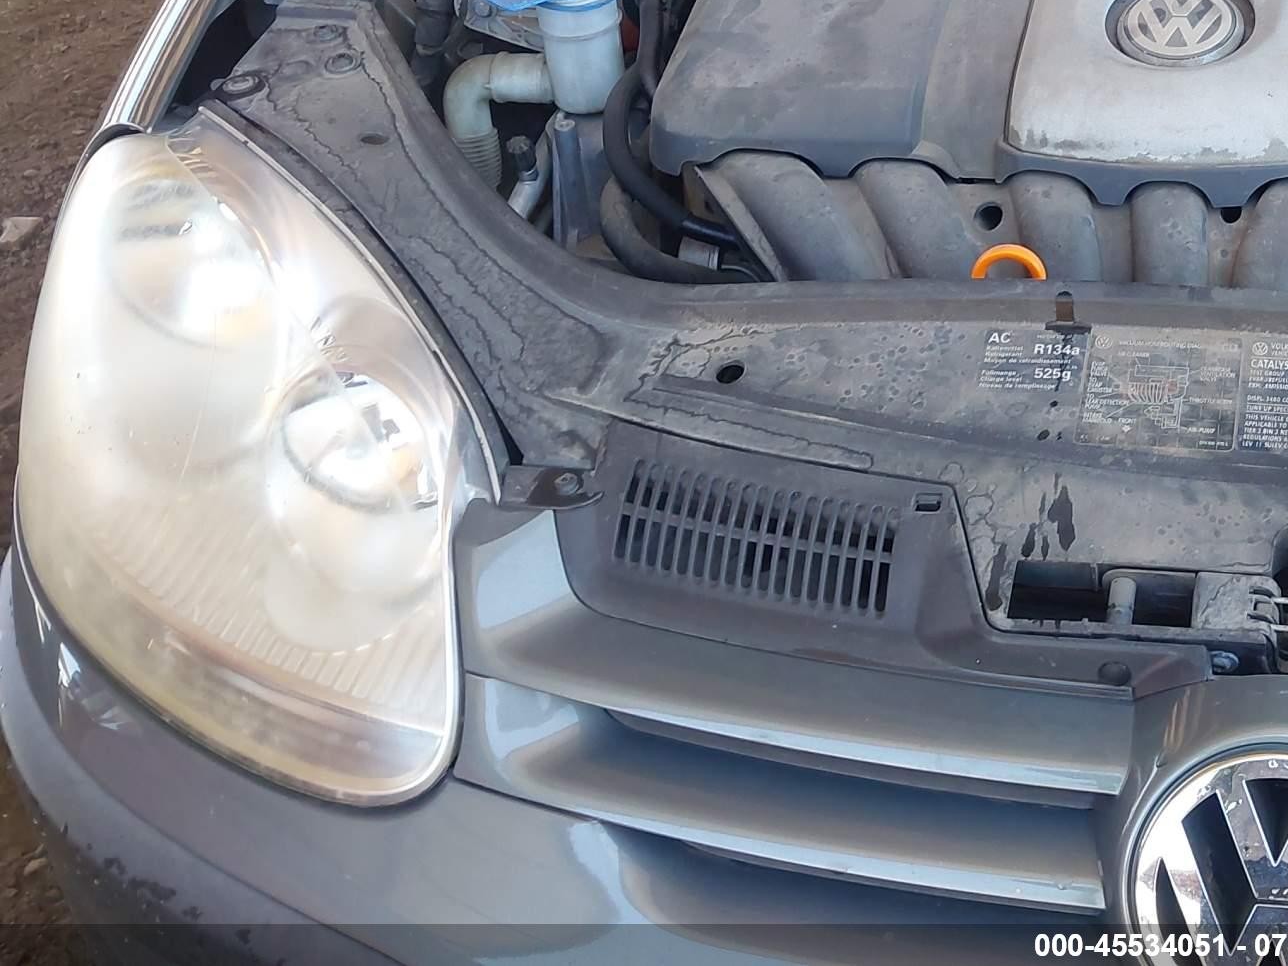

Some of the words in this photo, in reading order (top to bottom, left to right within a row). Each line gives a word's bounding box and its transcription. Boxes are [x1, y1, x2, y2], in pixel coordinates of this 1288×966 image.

[988, 332, 1012, 344] AC
[1033, 343, 1081, 356] R134a
[1033, 367, 1072, 382] 525g
[1245, 413, 1259, 421] THIS
[1259, 414, 1285, 422] VEHICLE
[1244, 420, 1278, 428] APPLICABLE
[1243, 433, 1282, 442] REGULATIONS
[1263, 441, 1283, 449] SULEV
